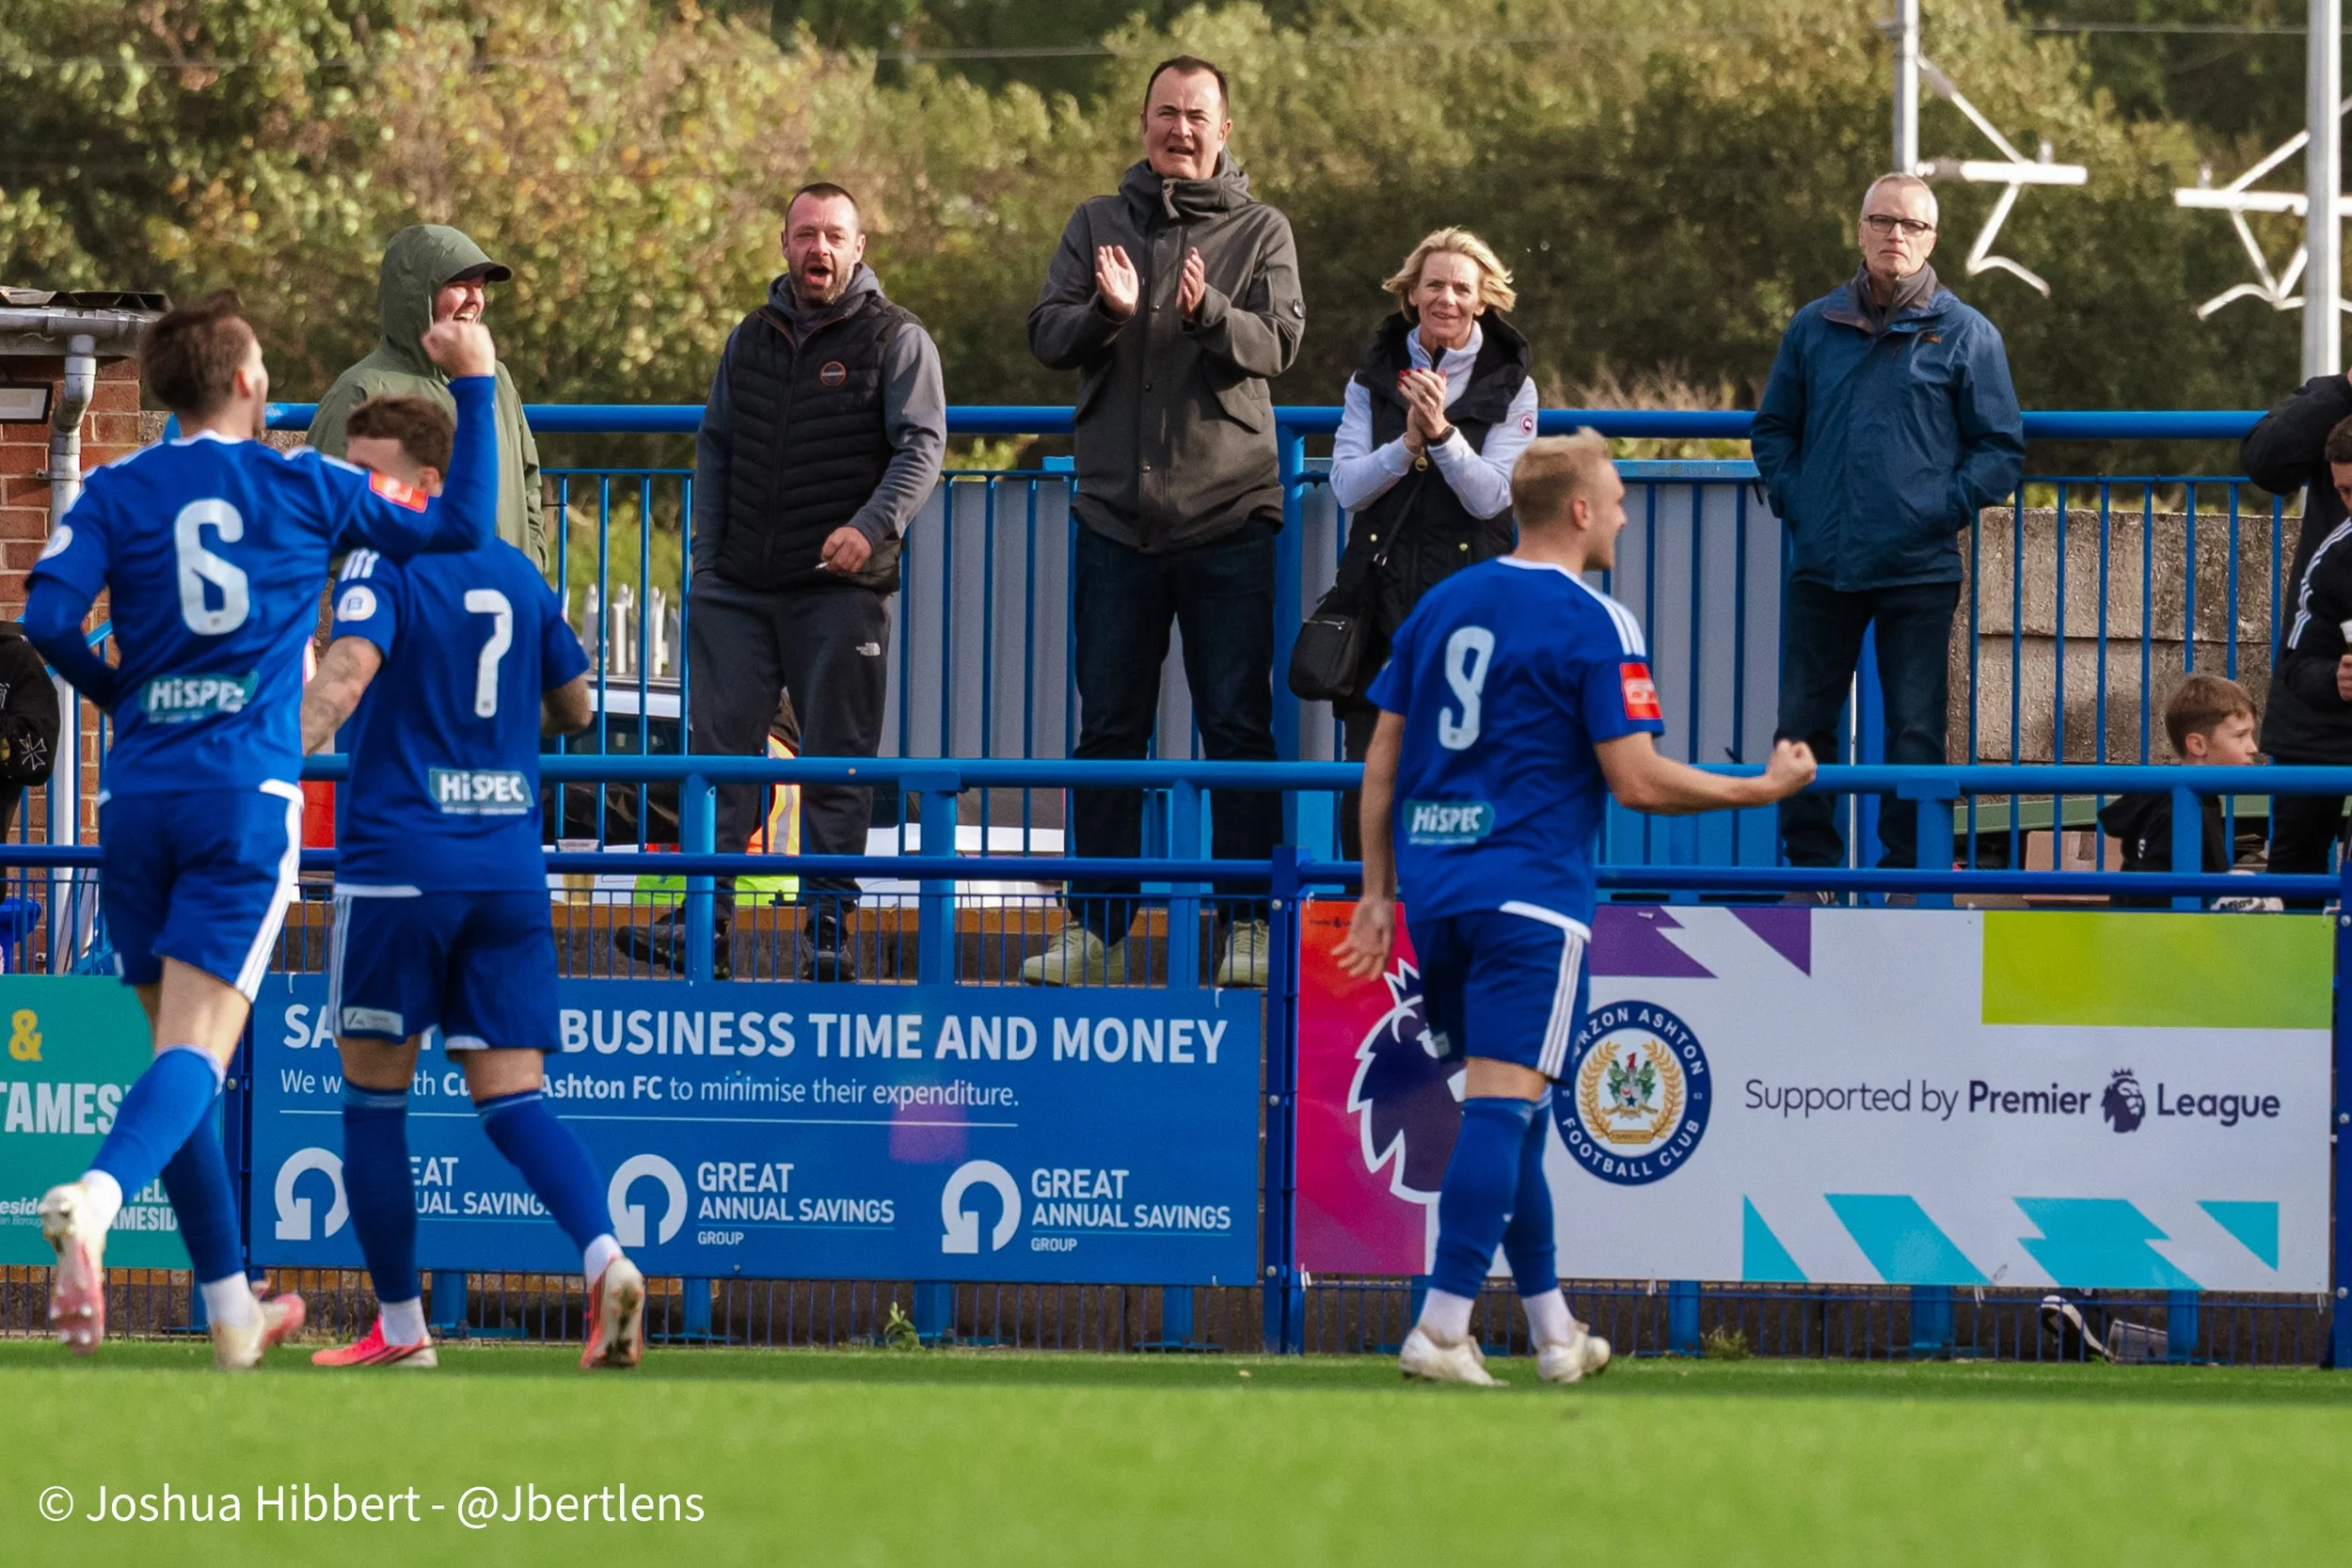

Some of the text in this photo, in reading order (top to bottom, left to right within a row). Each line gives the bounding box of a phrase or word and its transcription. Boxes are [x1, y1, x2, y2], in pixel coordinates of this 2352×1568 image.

[174, 498, 250, 635] 6
[464, 589, 513, 718] 7
[1438, 626, 1495, 751] 9
[8, 1009, 42, 1061] &
[283, 1004, 1228, 1064] SA BUSINESS TIME AND MONEY
[1638, 1008, 1704, 1075] ASHTON
[280, 1069, 316, 1094] We
[542, 1072, 626, 1099] Ashton
[633, 1075, 662, 1100] FC
[669, 1076, 693, 1101] to
[701, 1075, 806, 1102] minimise
[813, 1077, 867, 1103] their
[872, 1079, 1020, 1112] expenditure.
[1745, 1078, 2281, 1127] Supported by Premier League
[1563, 1117, 1653, 1177] FOOTBALL
[1659, 1119, 1700, 1166] CLUB
[410, 1157, 459, 1186] EAT
[697, 1162, 795, 1193] GREAT
[1031, 1168, 1130, 1199] GREAT
[463, 1191, 552, 1216] SAVING
[698, 1196, 895, 1223] ANNUAL SAVINGS
[1031, 1203, 1232, 1229] ANNUAL SAVINGS
[697, 1230, 744, 1245] GROUP
[1030, 1237, 1078, 1252] GROUP
